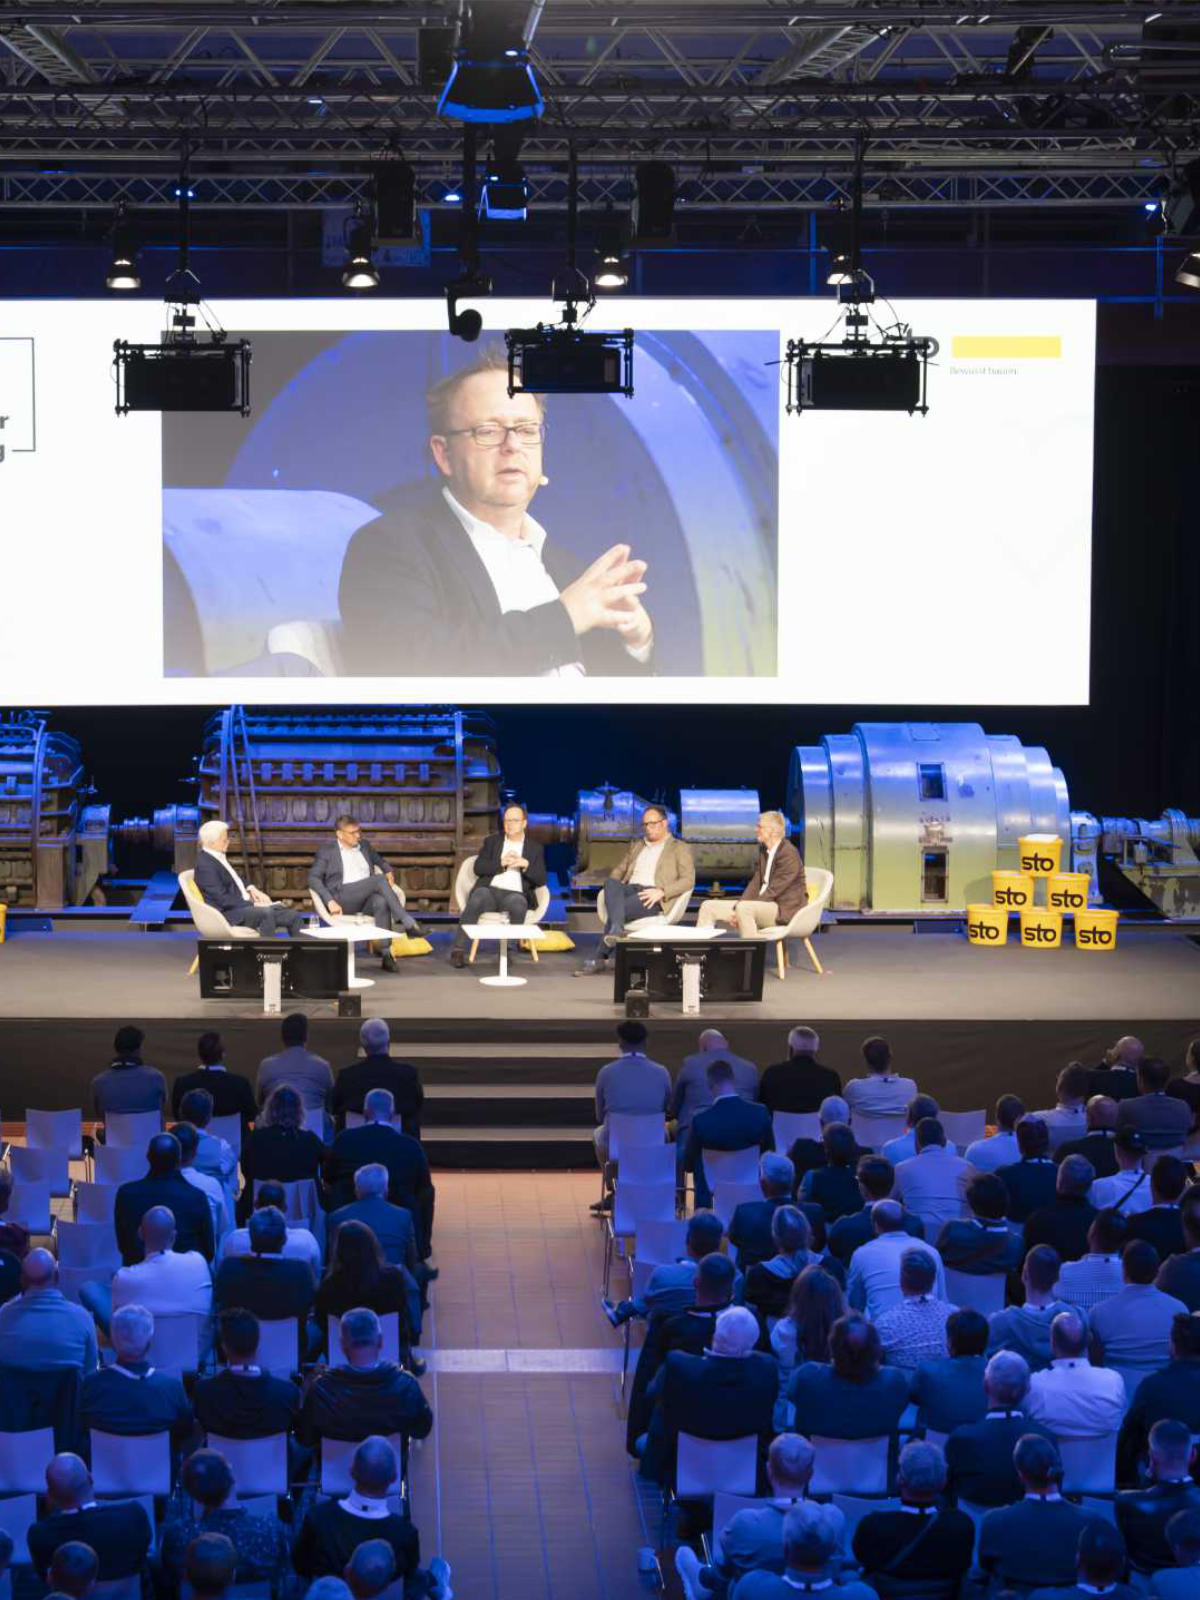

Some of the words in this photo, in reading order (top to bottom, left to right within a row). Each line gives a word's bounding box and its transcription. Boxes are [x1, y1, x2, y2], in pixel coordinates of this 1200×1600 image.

[1022, 852, 1054, 872] sto
[995, 886, 1027, 906] sto
[1051, 889, 1083, 908] sto
[969, 921, 999, 940] sto
[1024, 923, 1057, 942] sto
[1079, 926, 1112, 944] sto
